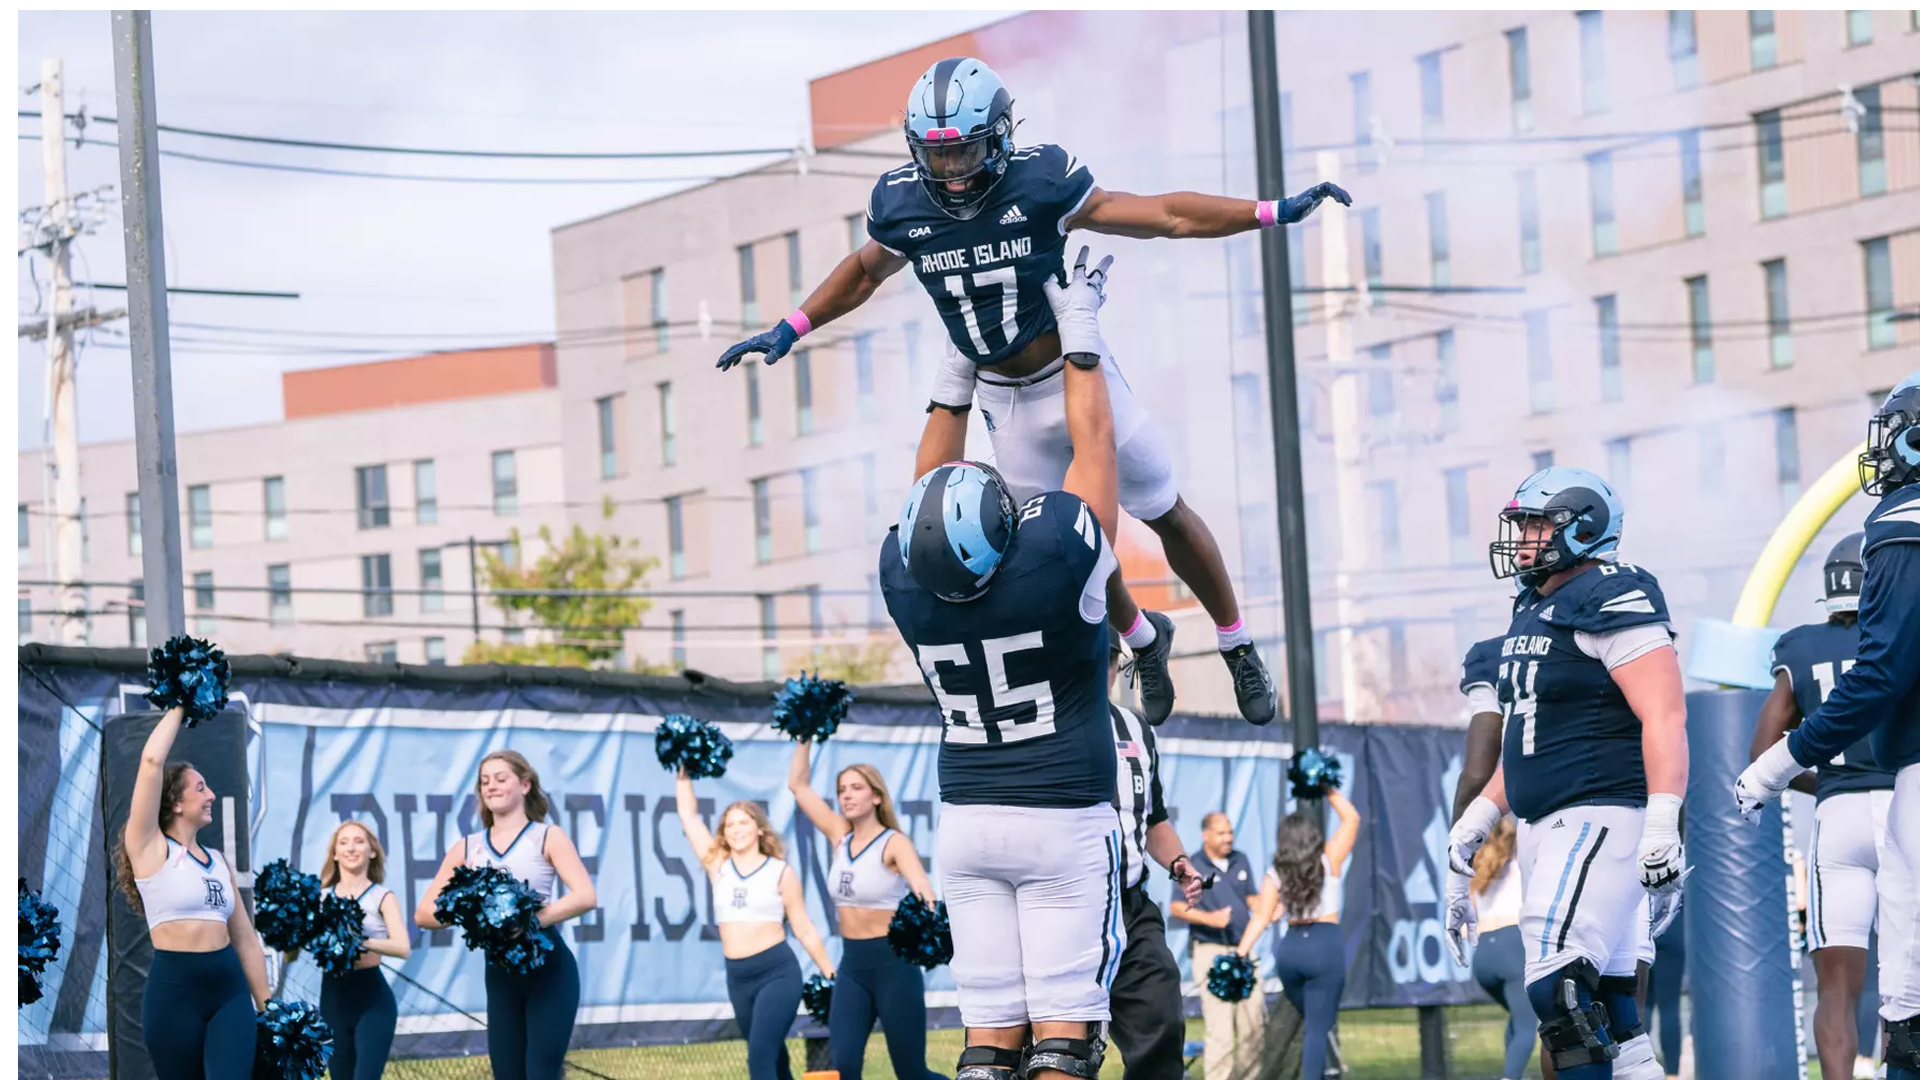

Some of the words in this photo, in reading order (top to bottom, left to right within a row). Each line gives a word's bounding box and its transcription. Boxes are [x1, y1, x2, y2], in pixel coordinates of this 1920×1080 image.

[908, 226, 932, 239] CAA
[921, 248, 969, 274] RHODE
[973, 236, 1032, 266] ISLAND
[944, 265, 1022, 356] 17
[1831, 570, 1852, 591] 14
[1514, 635, 1553, 656] ISLAND
[916, 630, 1056, 745] 65
[1133, 775, 1144, 794] B
